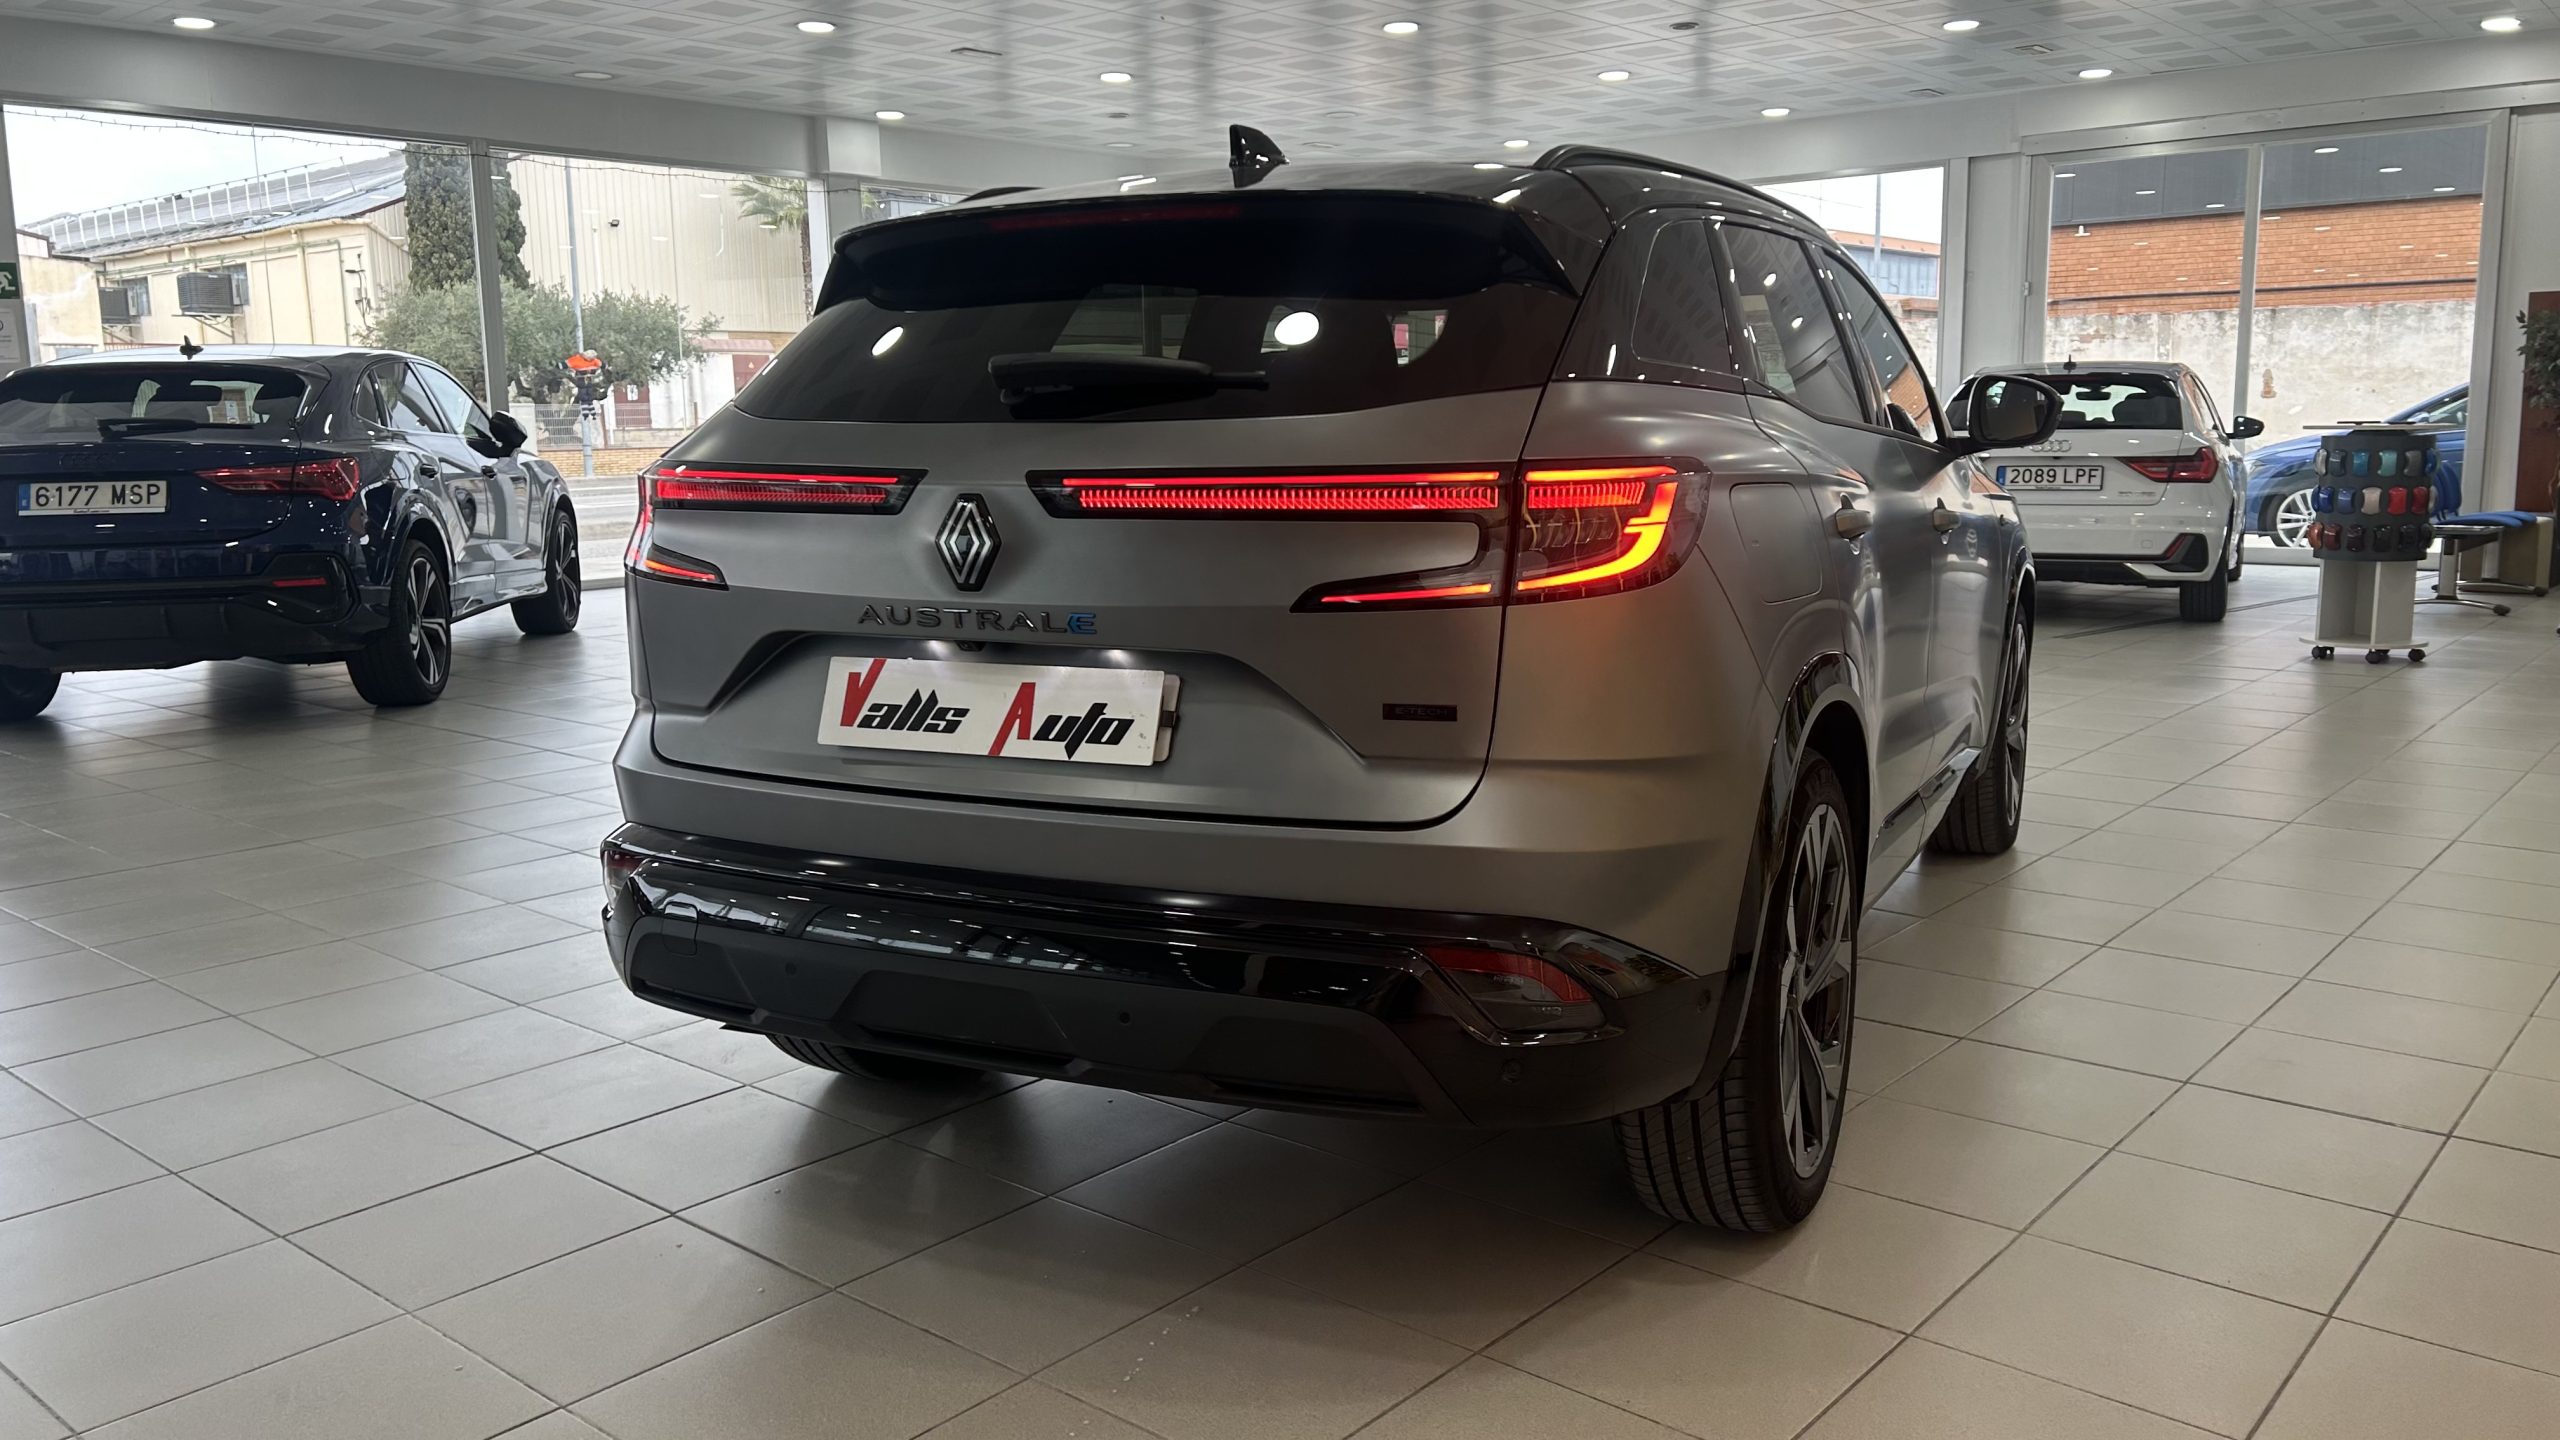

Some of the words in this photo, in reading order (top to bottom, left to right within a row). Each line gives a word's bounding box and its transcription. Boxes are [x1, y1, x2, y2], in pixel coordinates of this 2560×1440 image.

[2009, 468, 2057, 484] 2089
[2063, 468, 2099, 484] LPF
[35, 485, 99, 507] 6177
[111, 484, 161, 505] MSP
[857, 604, 1098, 635] AUSTRALE
[839, 658, 971, 734] Valls
[987, 682, 1135, 761] Auto
